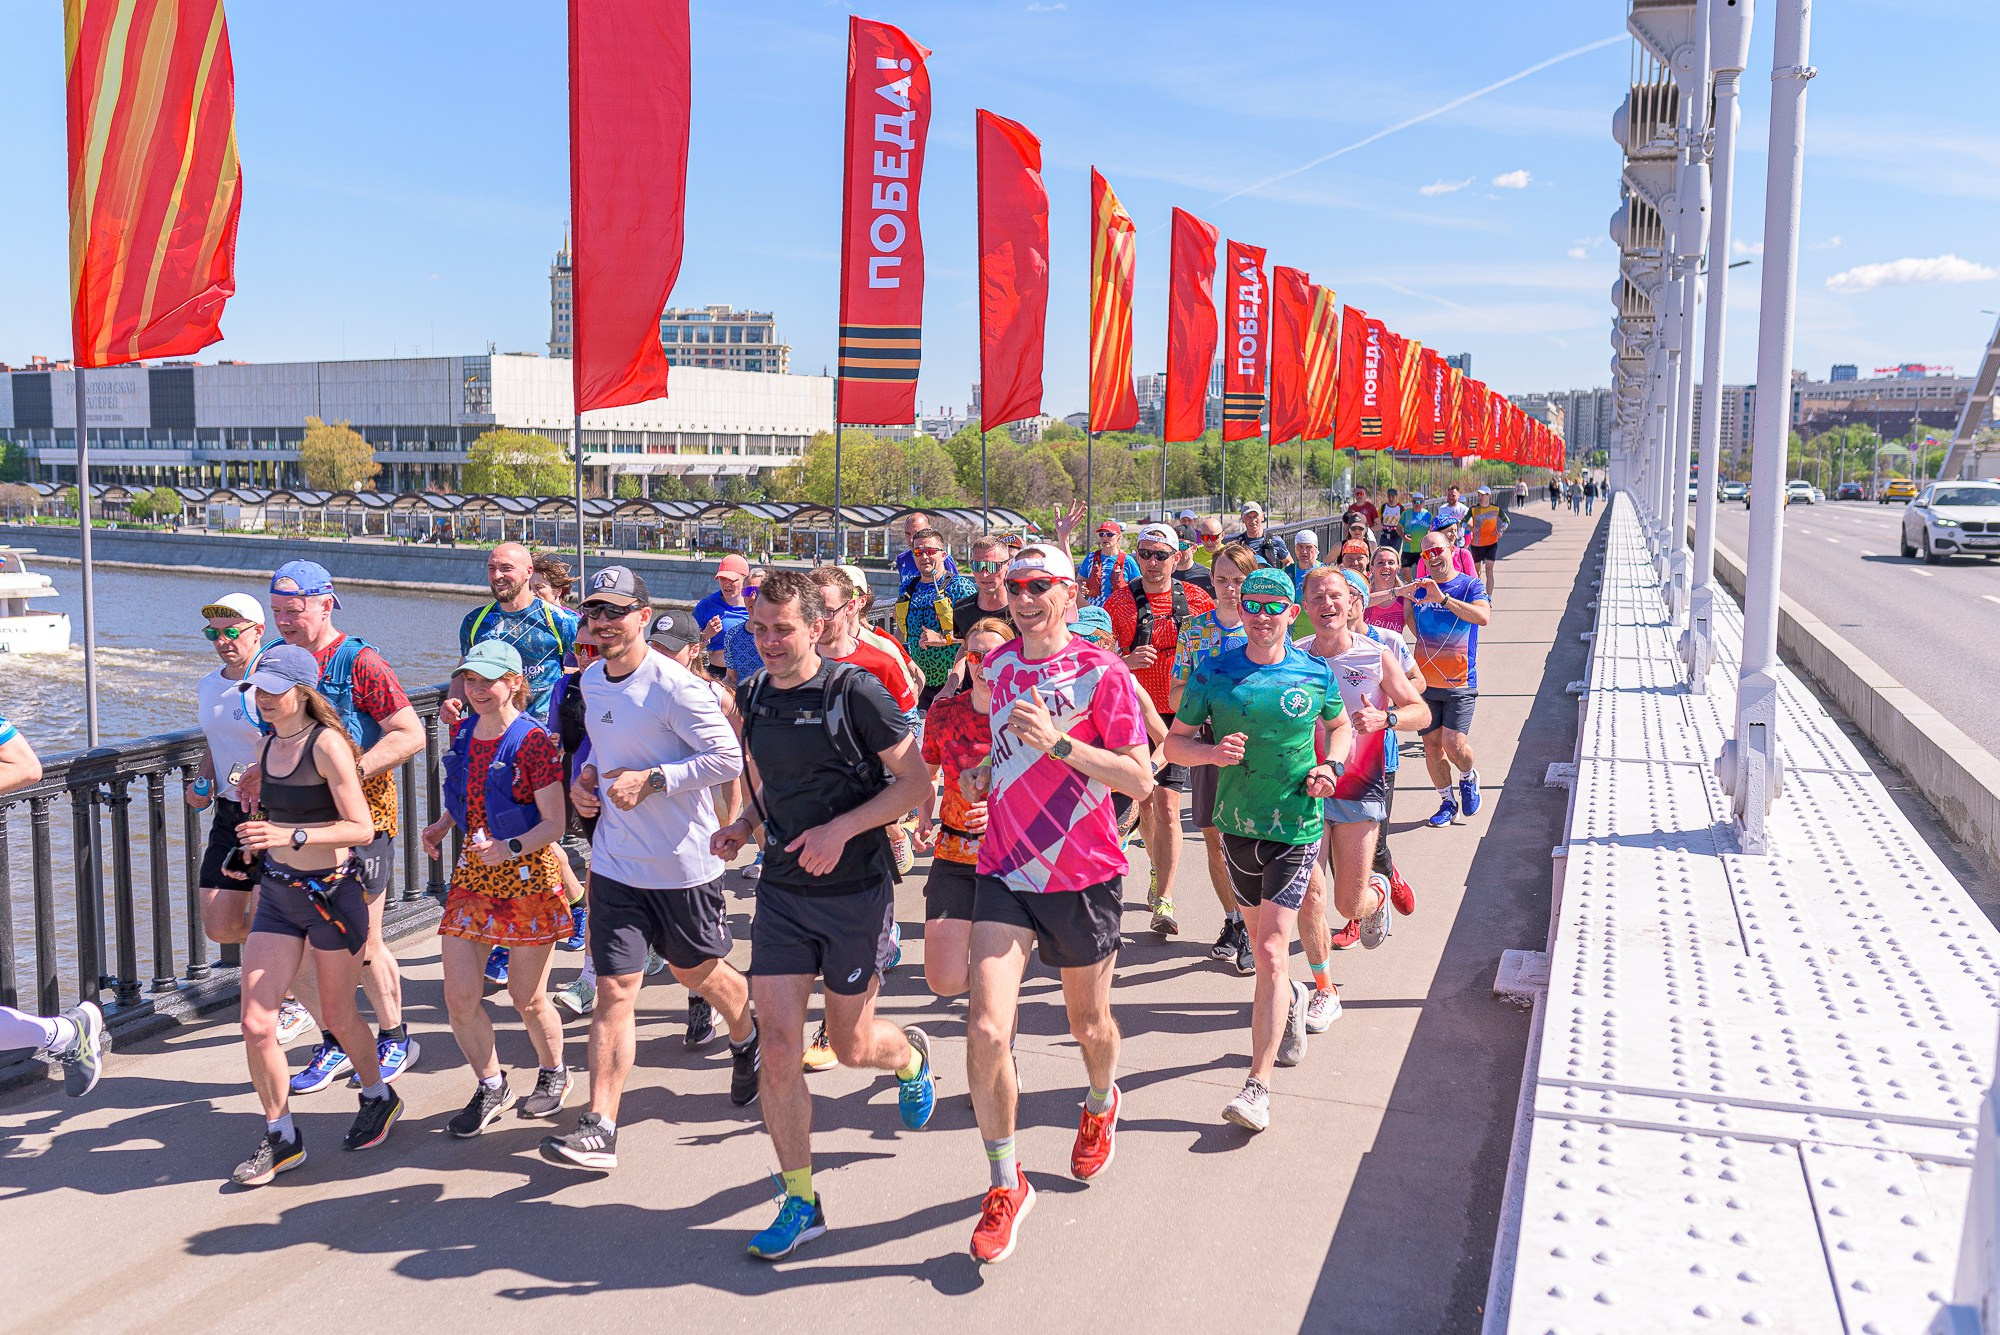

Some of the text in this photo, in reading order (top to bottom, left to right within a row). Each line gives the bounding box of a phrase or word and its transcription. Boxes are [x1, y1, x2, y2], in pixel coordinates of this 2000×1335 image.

[868, 56, 916, 290] ПОБЕДА!
[1237, 256, 1263, 376] ПОБЕДА!
[1363, 327, 1381, 407] ПОБЕДА!
